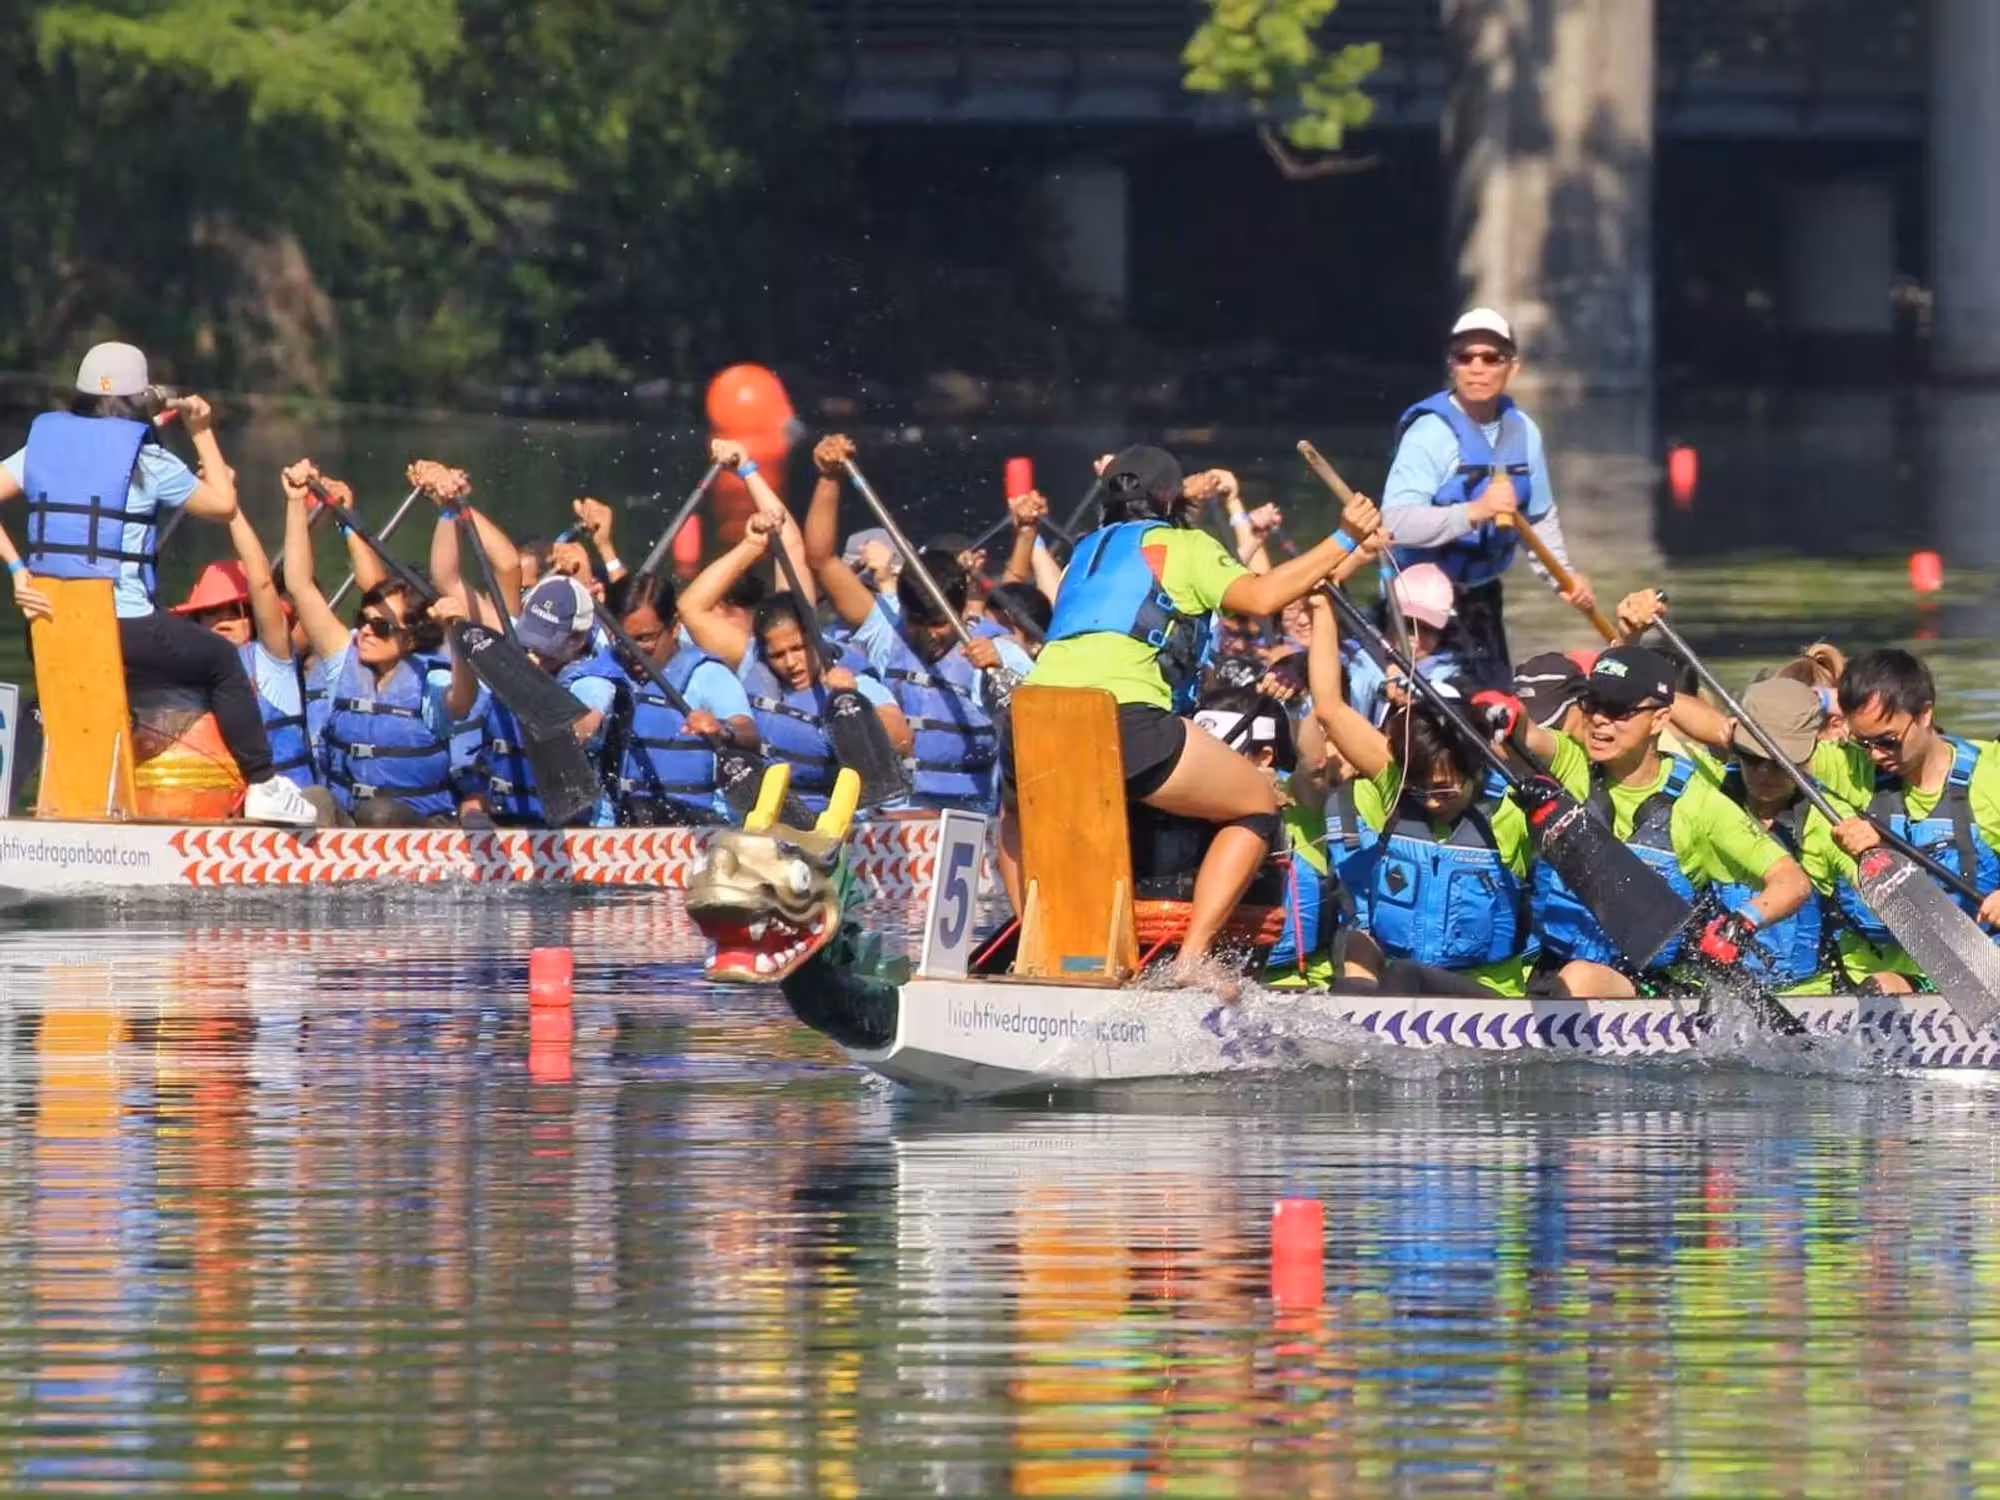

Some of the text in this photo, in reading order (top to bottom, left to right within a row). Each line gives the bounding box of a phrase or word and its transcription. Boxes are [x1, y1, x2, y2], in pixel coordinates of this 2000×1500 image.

[0, 834, 150, 868] hfivedragonboat.com
[938, 842, 975, 949] 5
[948, 1000, 1147, 1042] highfivedragonb.com
